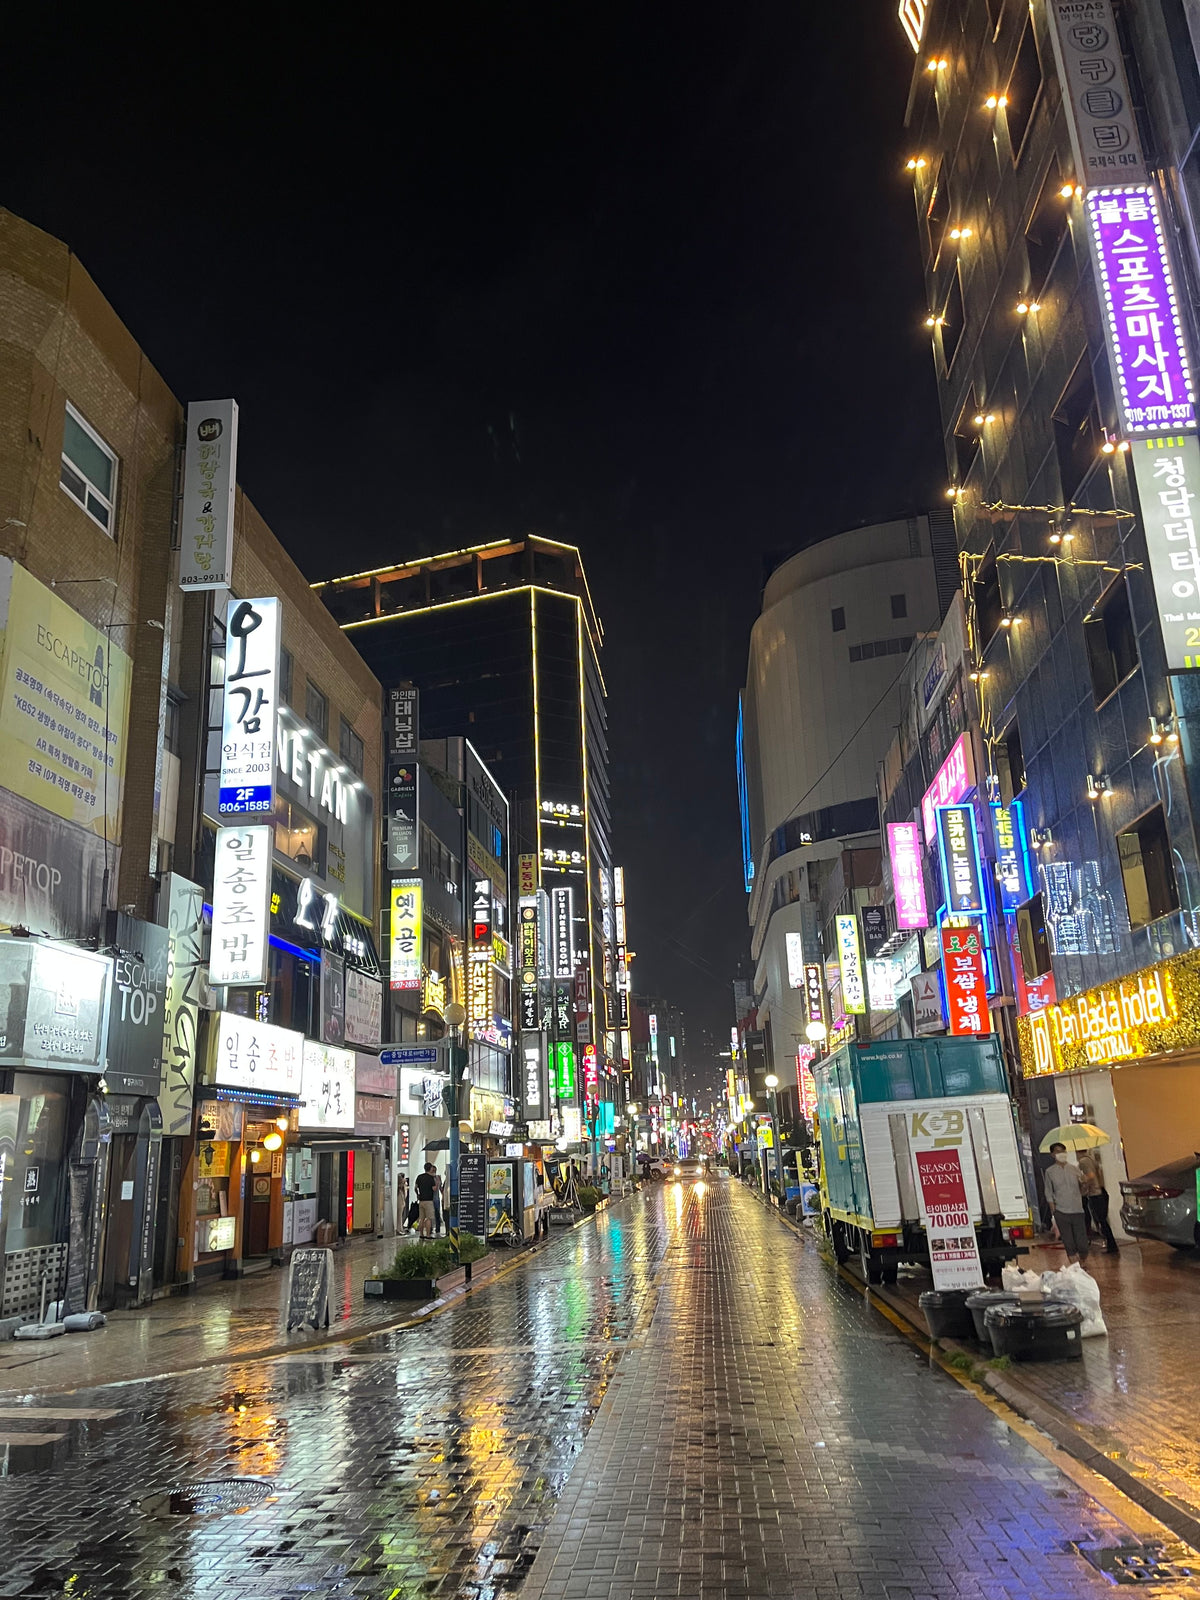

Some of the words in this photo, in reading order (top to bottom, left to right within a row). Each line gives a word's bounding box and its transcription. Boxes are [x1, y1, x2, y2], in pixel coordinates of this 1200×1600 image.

[1059, 2, 1104, 13] MIDAS
[1096, 197, 1151, 225] 볼륨
[1111, 228, 1174, 403] 스포츠마사지
[202, 501, 213, 514] &
[181, 573, 224, 584] 803-9911
[1184, 627, 1200, 647] 2
[37, 624, 110, 691] ESCAPETOP
[227, 601, 272, 735] 오감
[15, 667, 43, 695] 공포영화
[37, 710, 57, 732] 생방송
[36, 737, 47, 752] AR
[223, 741, 271, 761] 일식점
[28, 759, 43, 776] 전국
[43, 768, 58, 784] 10개
[58, 776, 71, 792] 직영
[71, 784, 84, 799] 매장
[84, 791, 97, 806] 운영
[222, 767, 243, 775] SINCE
[245, 763, 271, 774] 2003
[219, 800, 270, 813] 806-1585
[235, 788, 255, 801] 2F
[397, 844, 408, 854] B1
[521, 861, 534, 892] 부동산
[221, 833, 258, 963] 일송초밥
[473, 880, 491, 923] 제스트
[395, 894, 417, 953] 옛골
[558, 890, 567, 939] BUSINESS
[116, 959, 164, 994] ESCAPE
[118, 985, 158, 1026] TOP
[1078, 990, 1122, 1039] Basta
[1120, 970, 1167, 1030] hotel
[226, 1031, 296, 1079] 일송초밥
[861, 1053, 903, 1061] www.kgb.co.kr
[1085, 1033, 1133, 1063] CENTRAL
[911, 1109, 965, 1138] KGB
[920, 1162, 960, 1174] SEASON
[922, 1173, 962, 1186] EVENT
[926, 1203, 967, 1214] 타이마사지
[928, 1213, 969, 1228] 70,000
